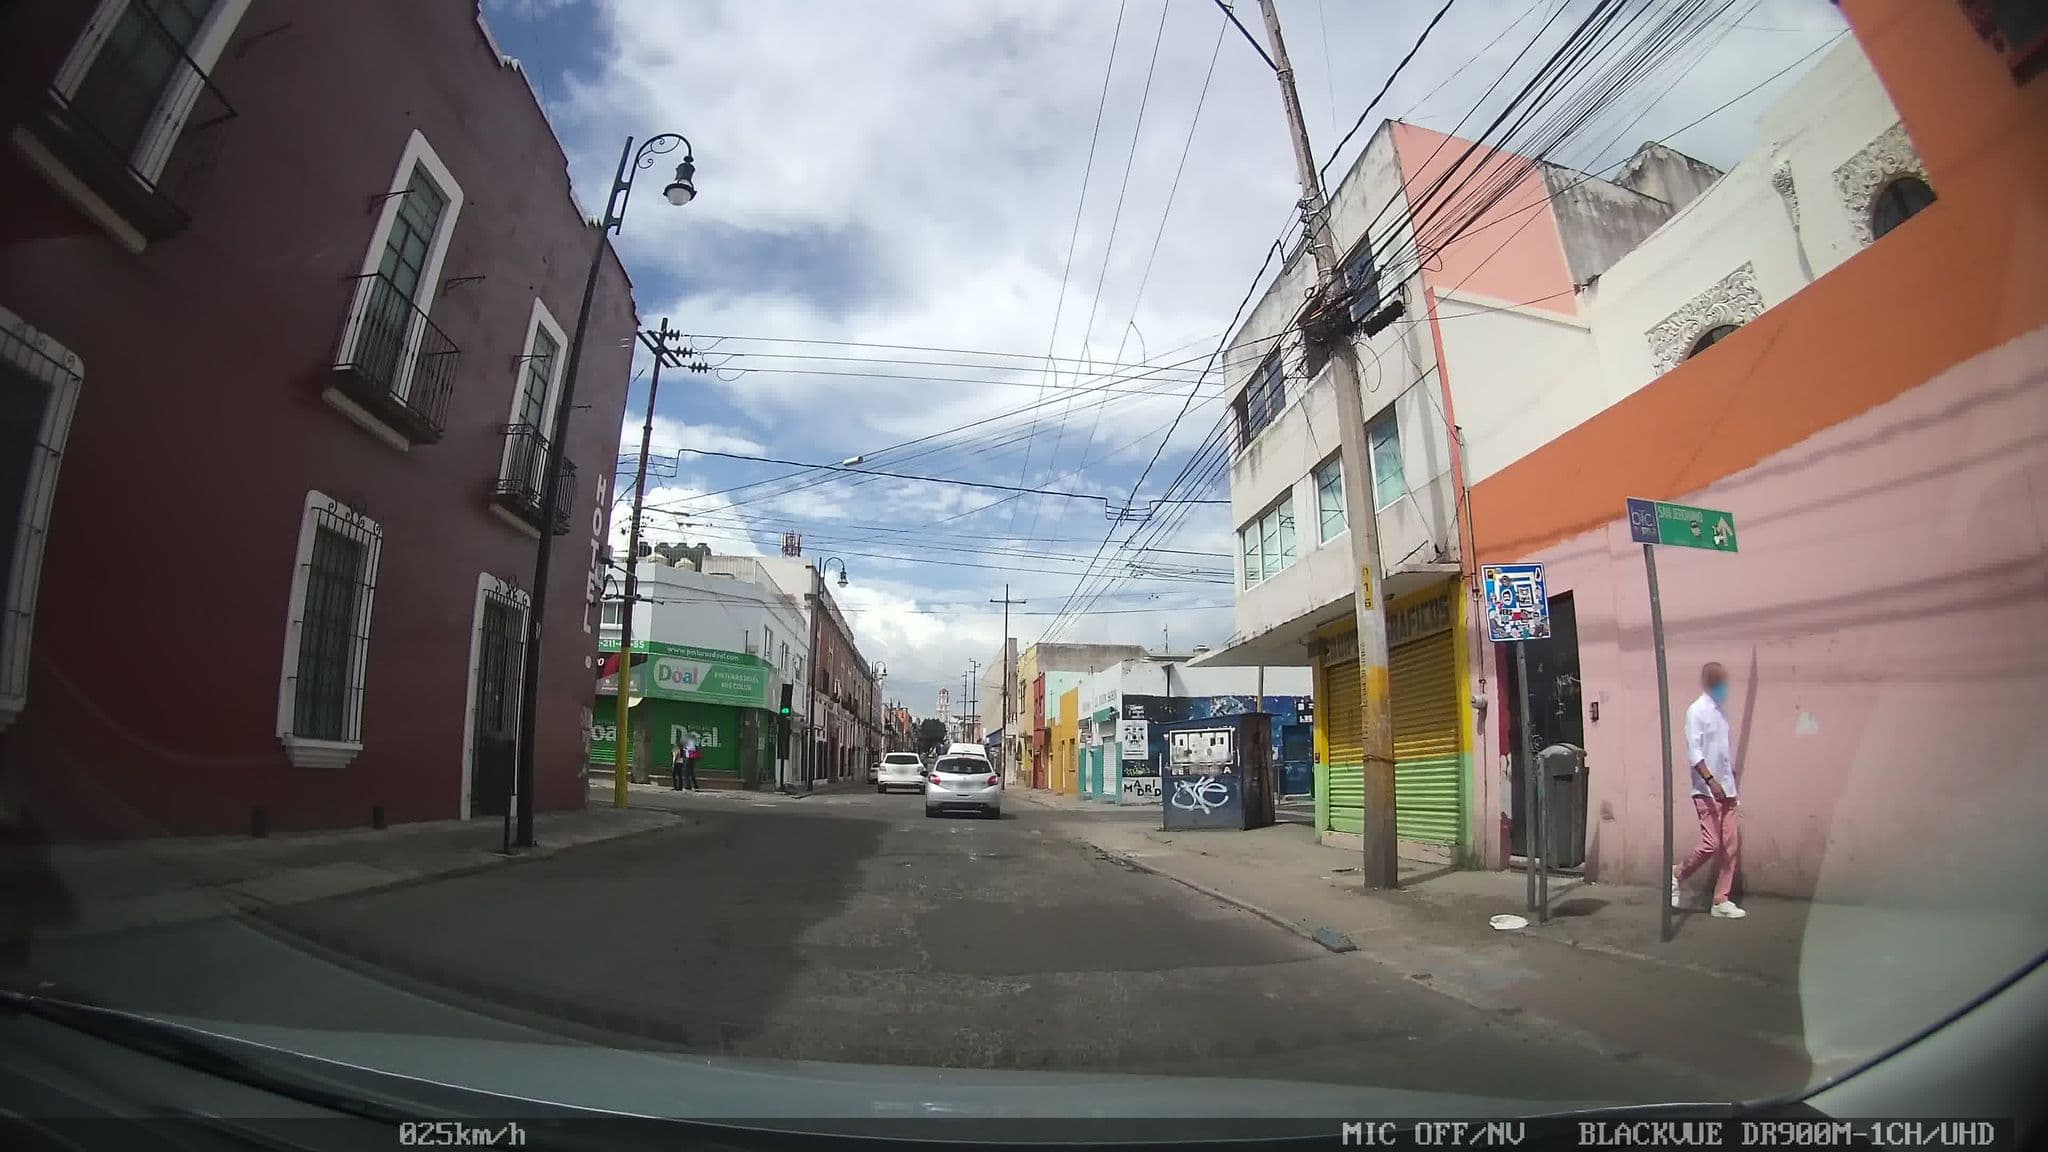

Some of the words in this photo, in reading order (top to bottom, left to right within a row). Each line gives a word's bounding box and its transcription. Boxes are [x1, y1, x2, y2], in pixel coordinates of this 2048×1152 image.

[583, 474, 607, 634] HOTEL
[658, 663, 699, 685] Doal
[1123, 779, 1162, 797] MADRID
